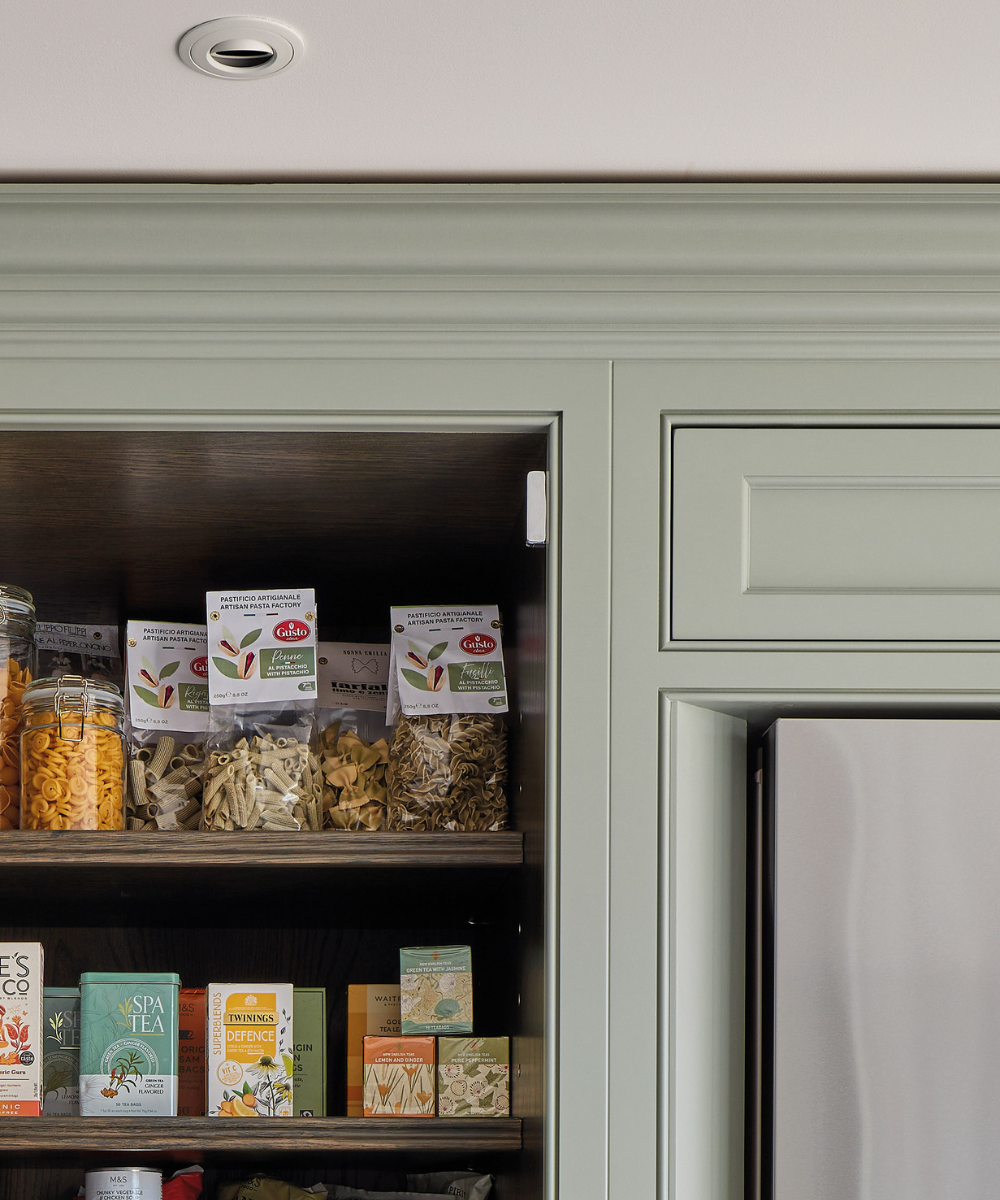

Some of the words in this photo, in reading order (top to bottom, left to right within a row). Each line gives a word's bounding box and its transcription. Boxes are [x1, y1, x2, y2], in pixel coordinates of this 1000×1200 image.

[276, 628, 307, 637] Gusto
[463, 640, 494, 649] Gusto
[133, 996, 165, 1014] SPA
[128, 1014, 165, 1032] TEA
[213, 992, 221, 1055] SUPERBLENDS
[228, 1014, 274, 1022] TWININGS
[227, 1030, 275, 1042] DEFENCE
